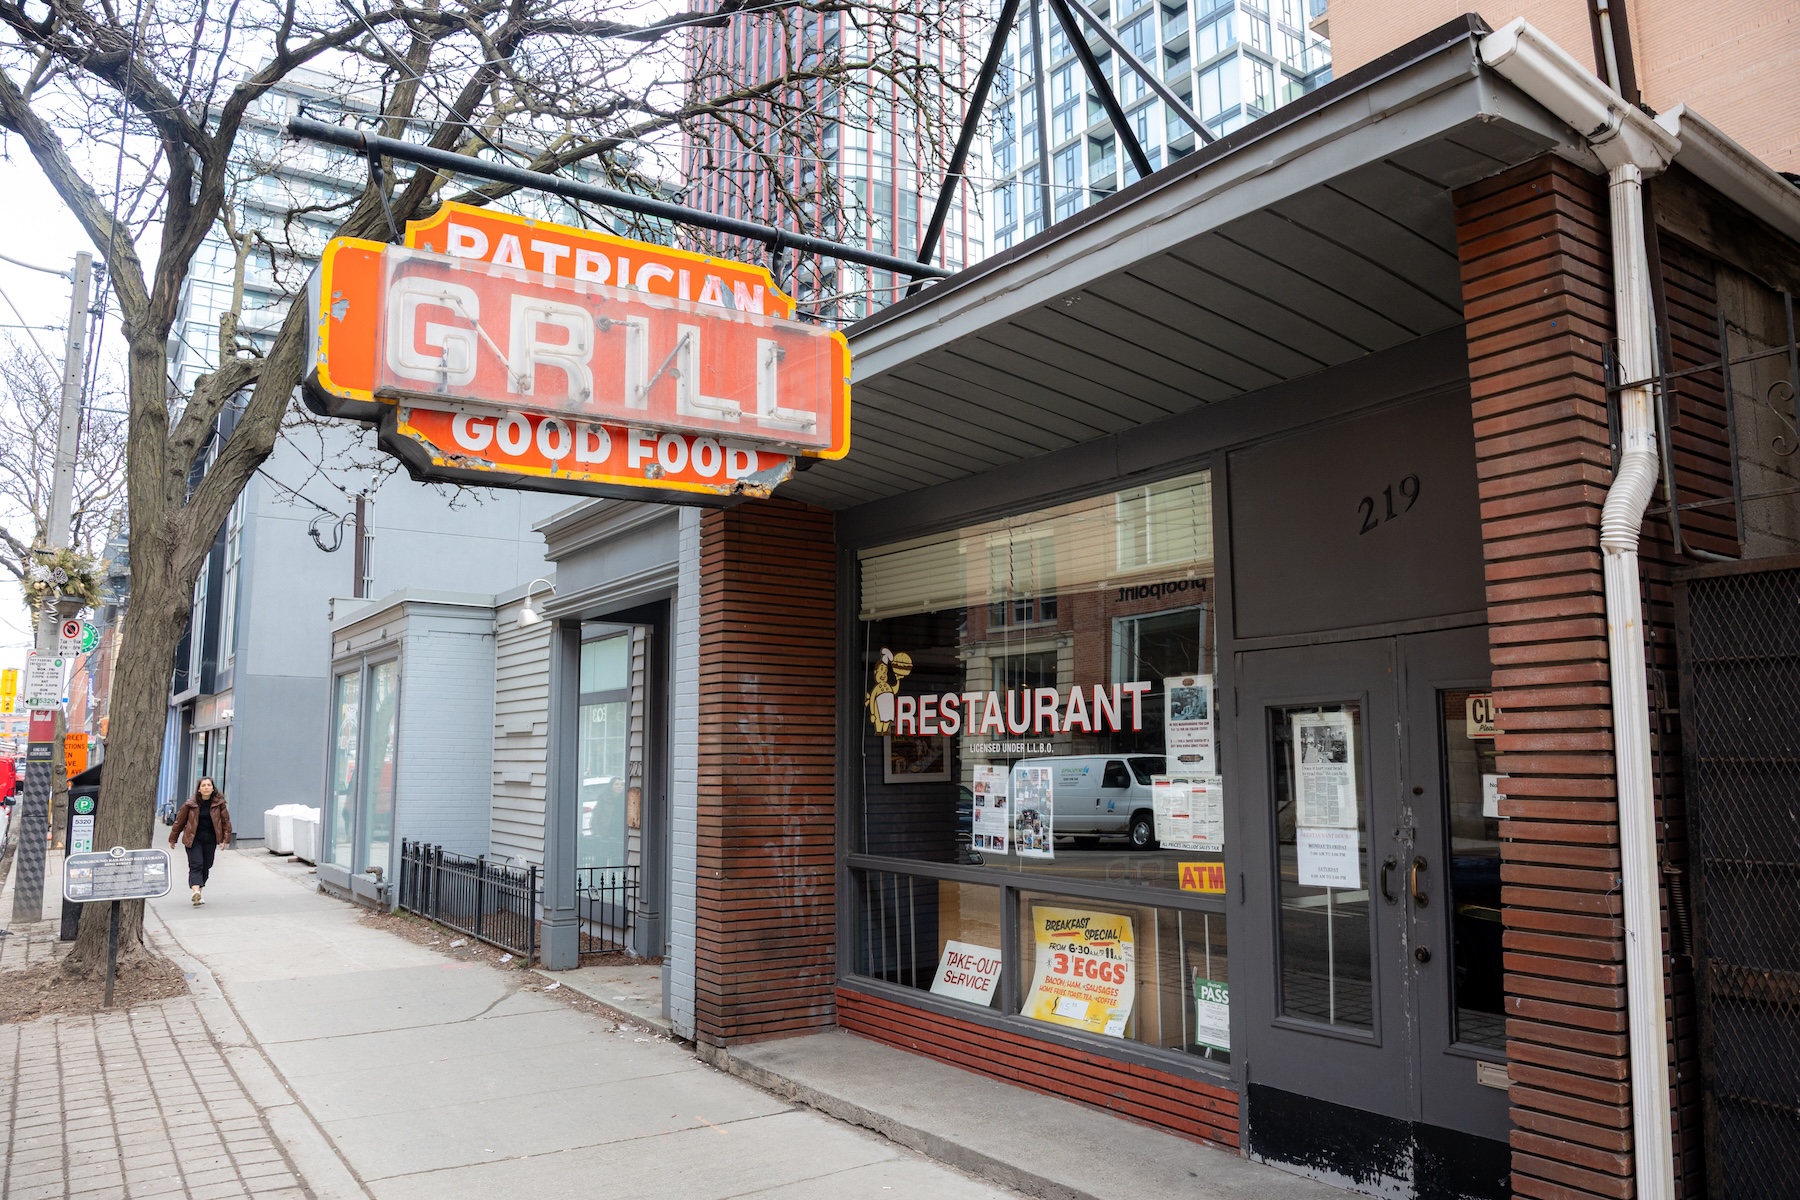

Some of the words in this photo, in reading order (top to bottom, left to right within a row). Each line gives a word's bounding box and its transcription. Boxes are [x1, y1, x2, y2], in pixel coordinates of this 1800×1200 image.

[447, 222, 766, 324] PATRICIAN
[385, 275, 818, 435] GRILL
[451, 412, 612, 464] GOOD
[627, 430, 760, 480] FOOD
[1358, 473, 1420, 535] 219
[896, 681, 1151, 736] RESTAURANT
[1472, 698, 1499, 724] CL
[970, 743, 1001, 753] LICENSED
[1002, 743, 1025, 753] UNDER
[1026, 743, 1054, 753] L.L.B.O.
[1181, 866, 1224, 889] ATM
[1045, 918, 1091, 931] BREAKFAST
[1084, 926, 1123, 943] SPECIAL!
[1049, 943, 1066, 951] FROM
[1105, 948, 1114, 959] 11
[947, 951, 1002, 976] TAKE-OUT
[1053, 953, 1069, 975] 3
[944, 970, 991, 992] SERVICE
[1201, 986, 1229, 1005] PASS
